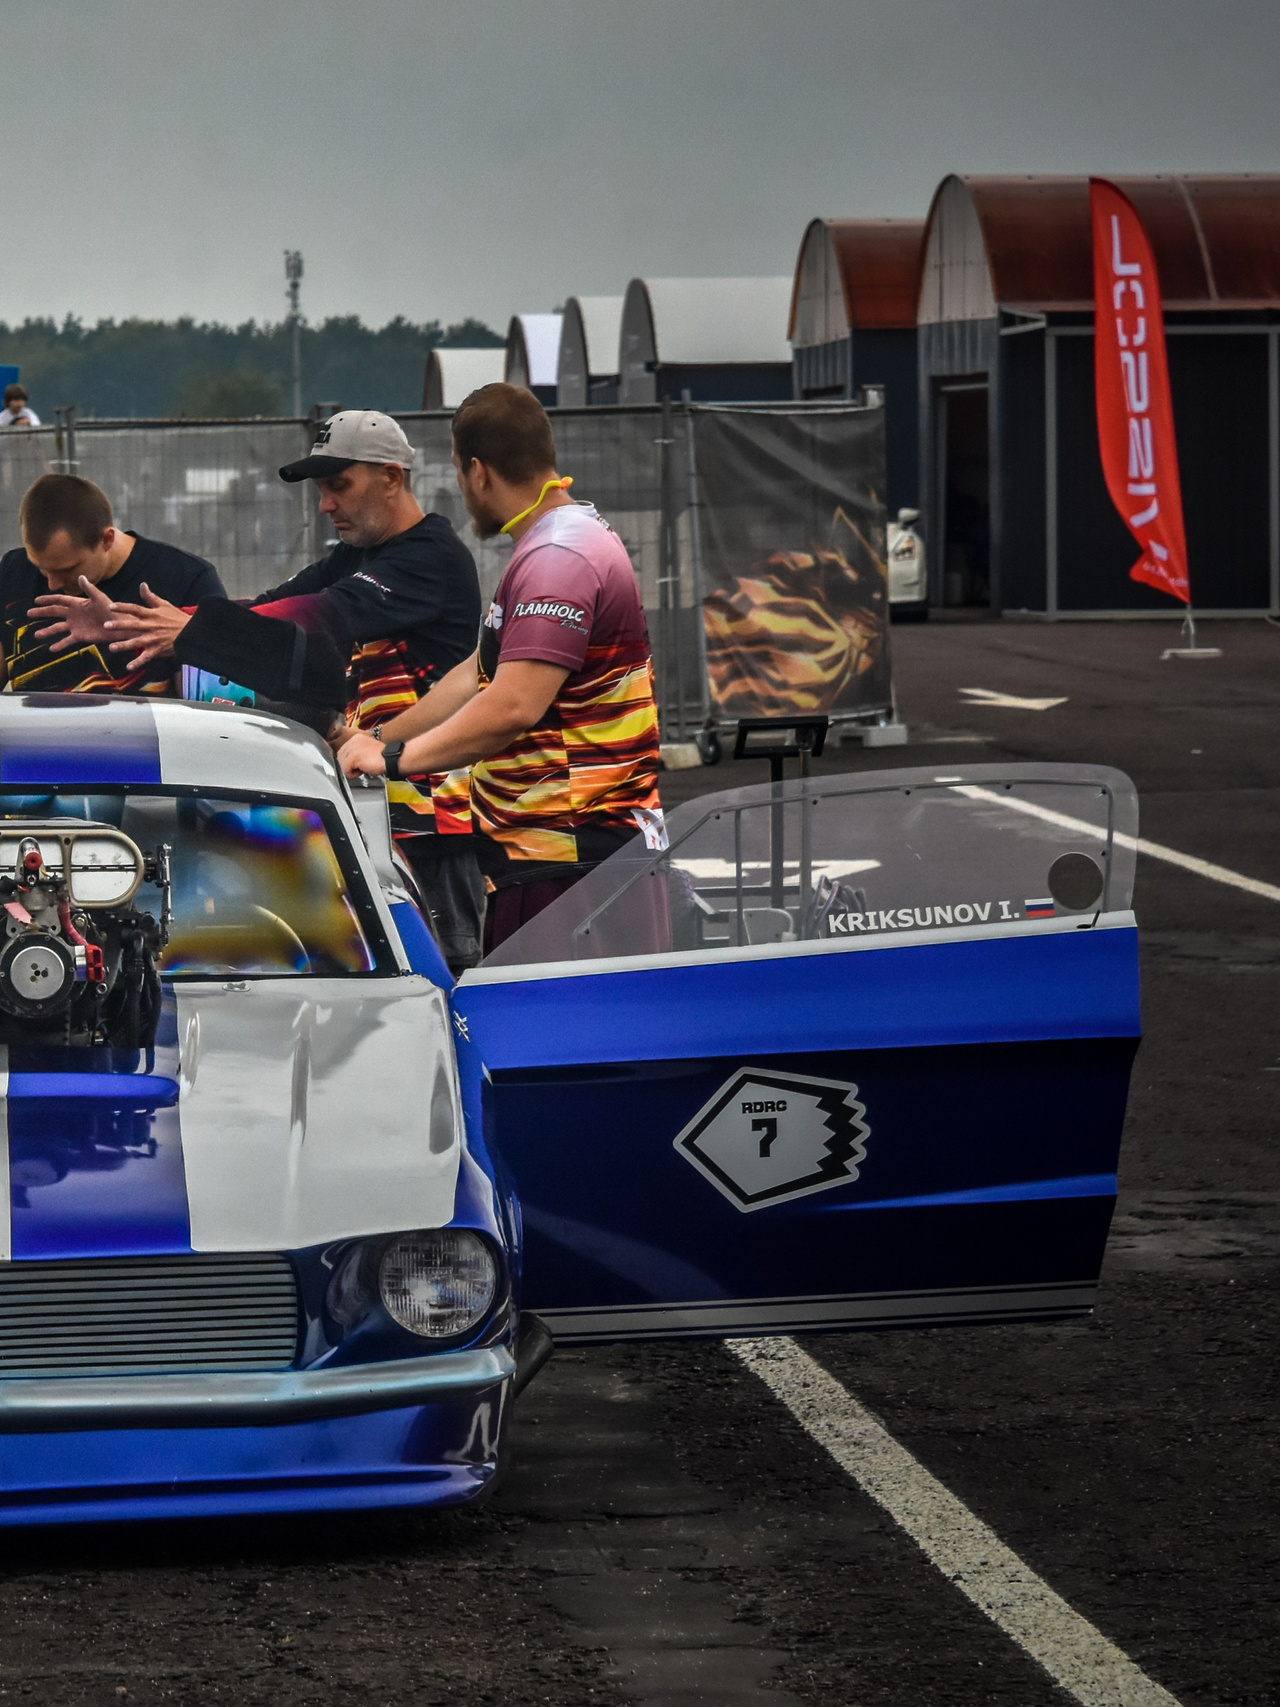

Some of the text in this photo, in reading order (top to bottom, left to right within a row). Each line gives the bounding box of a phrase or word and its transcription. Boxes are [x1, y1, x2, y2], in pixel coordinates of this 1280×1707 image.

[512, 602, 585, 622] FLAMHOLC
[828, 900, 1020, 933] KRIKSUNOV I.
[741, 1099, 787, 1114] RDRC
[751, 1117, 778, 1158] 7
